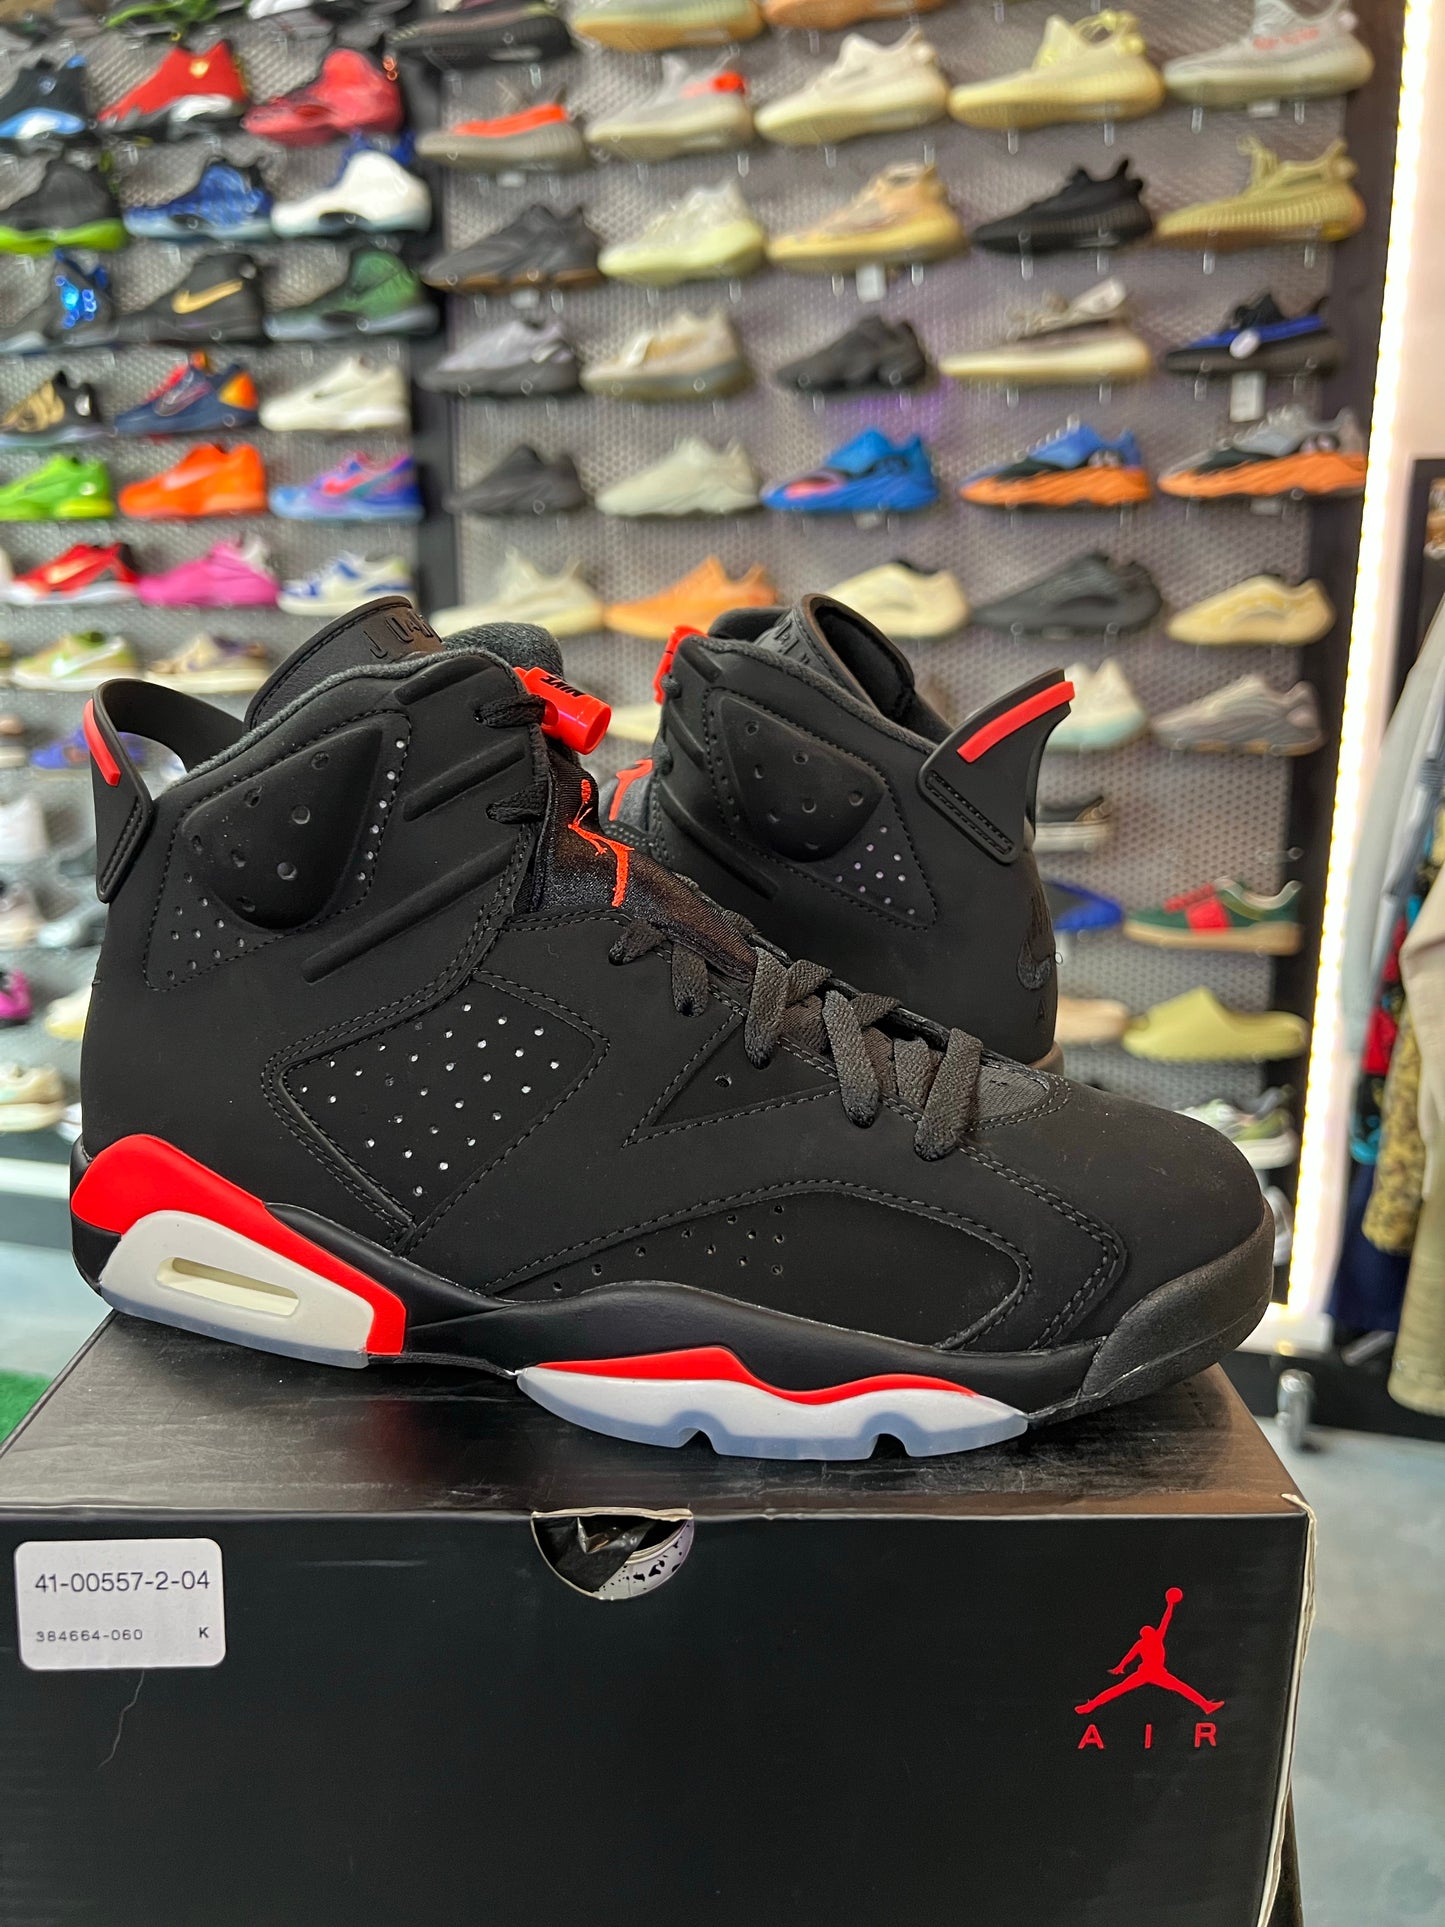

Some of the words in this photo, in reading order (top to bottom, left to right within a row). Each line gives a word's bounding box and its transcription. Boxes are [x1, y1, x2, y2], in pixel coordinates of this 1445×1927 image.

[35, 1571, 209, 1592] 41-00557-2-04
[37, 1629, 142, 1642] 384664-060
[199, 1627, 208, 1638] K
[1078, 1723, 1216, 1749] AIR
